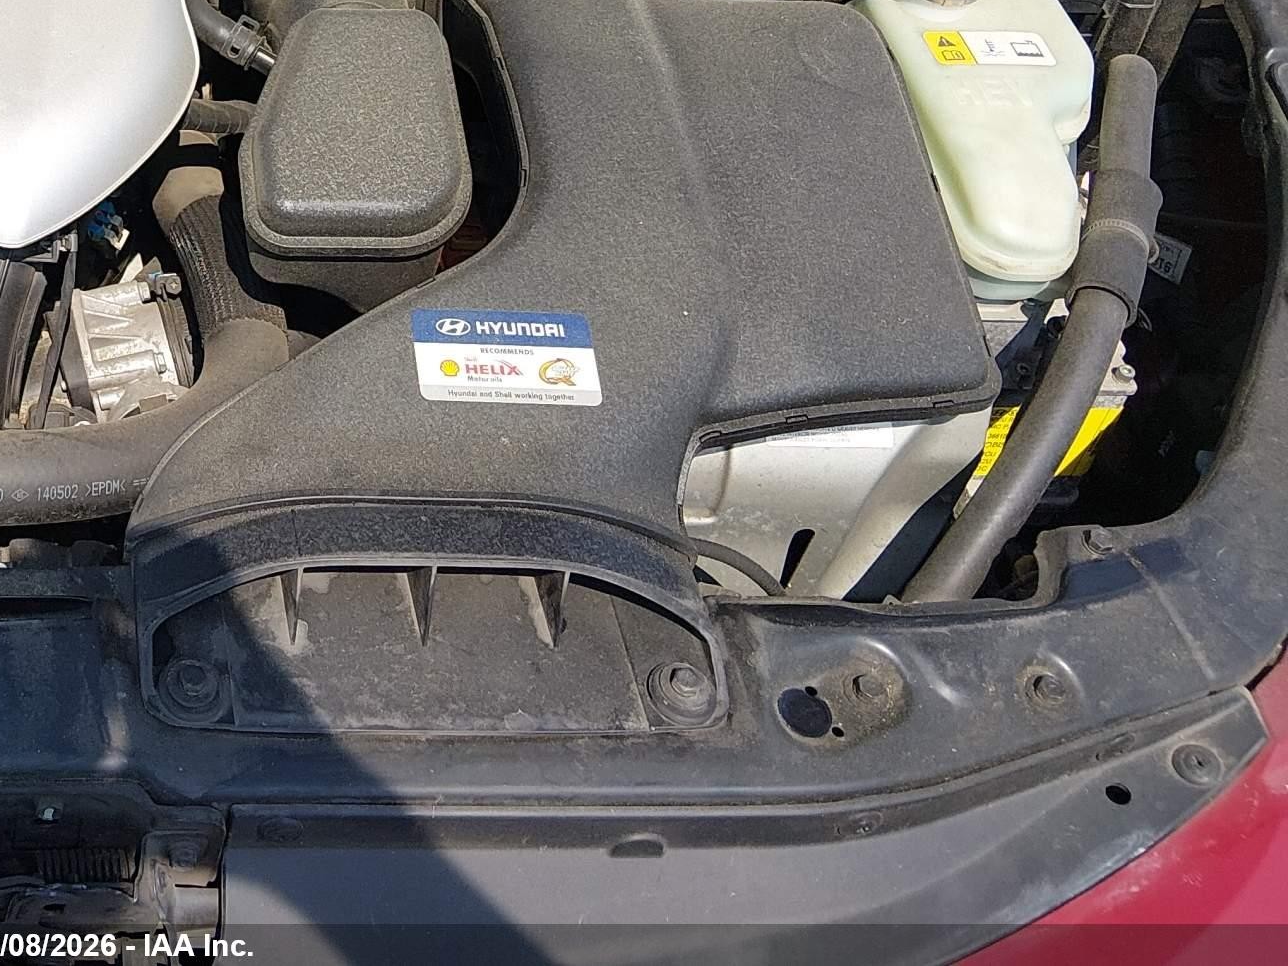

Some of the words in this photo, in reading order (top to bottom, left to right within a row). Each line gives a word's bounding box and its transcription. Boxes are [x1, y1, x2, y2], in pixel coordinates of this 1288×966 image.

[475, 320, 565, 338] HYUNDAI
[480, 347, 534, 356] RECOMMENDS
[465, 361, 521, 376] HELIX
[447, 388, 478, 399] Hyundai
[479, 390, 493, 398] and
[494, 390, 513, 399] Shell
[514, 392, 543, 402] working
[37, 484, 79, 501] 140502
